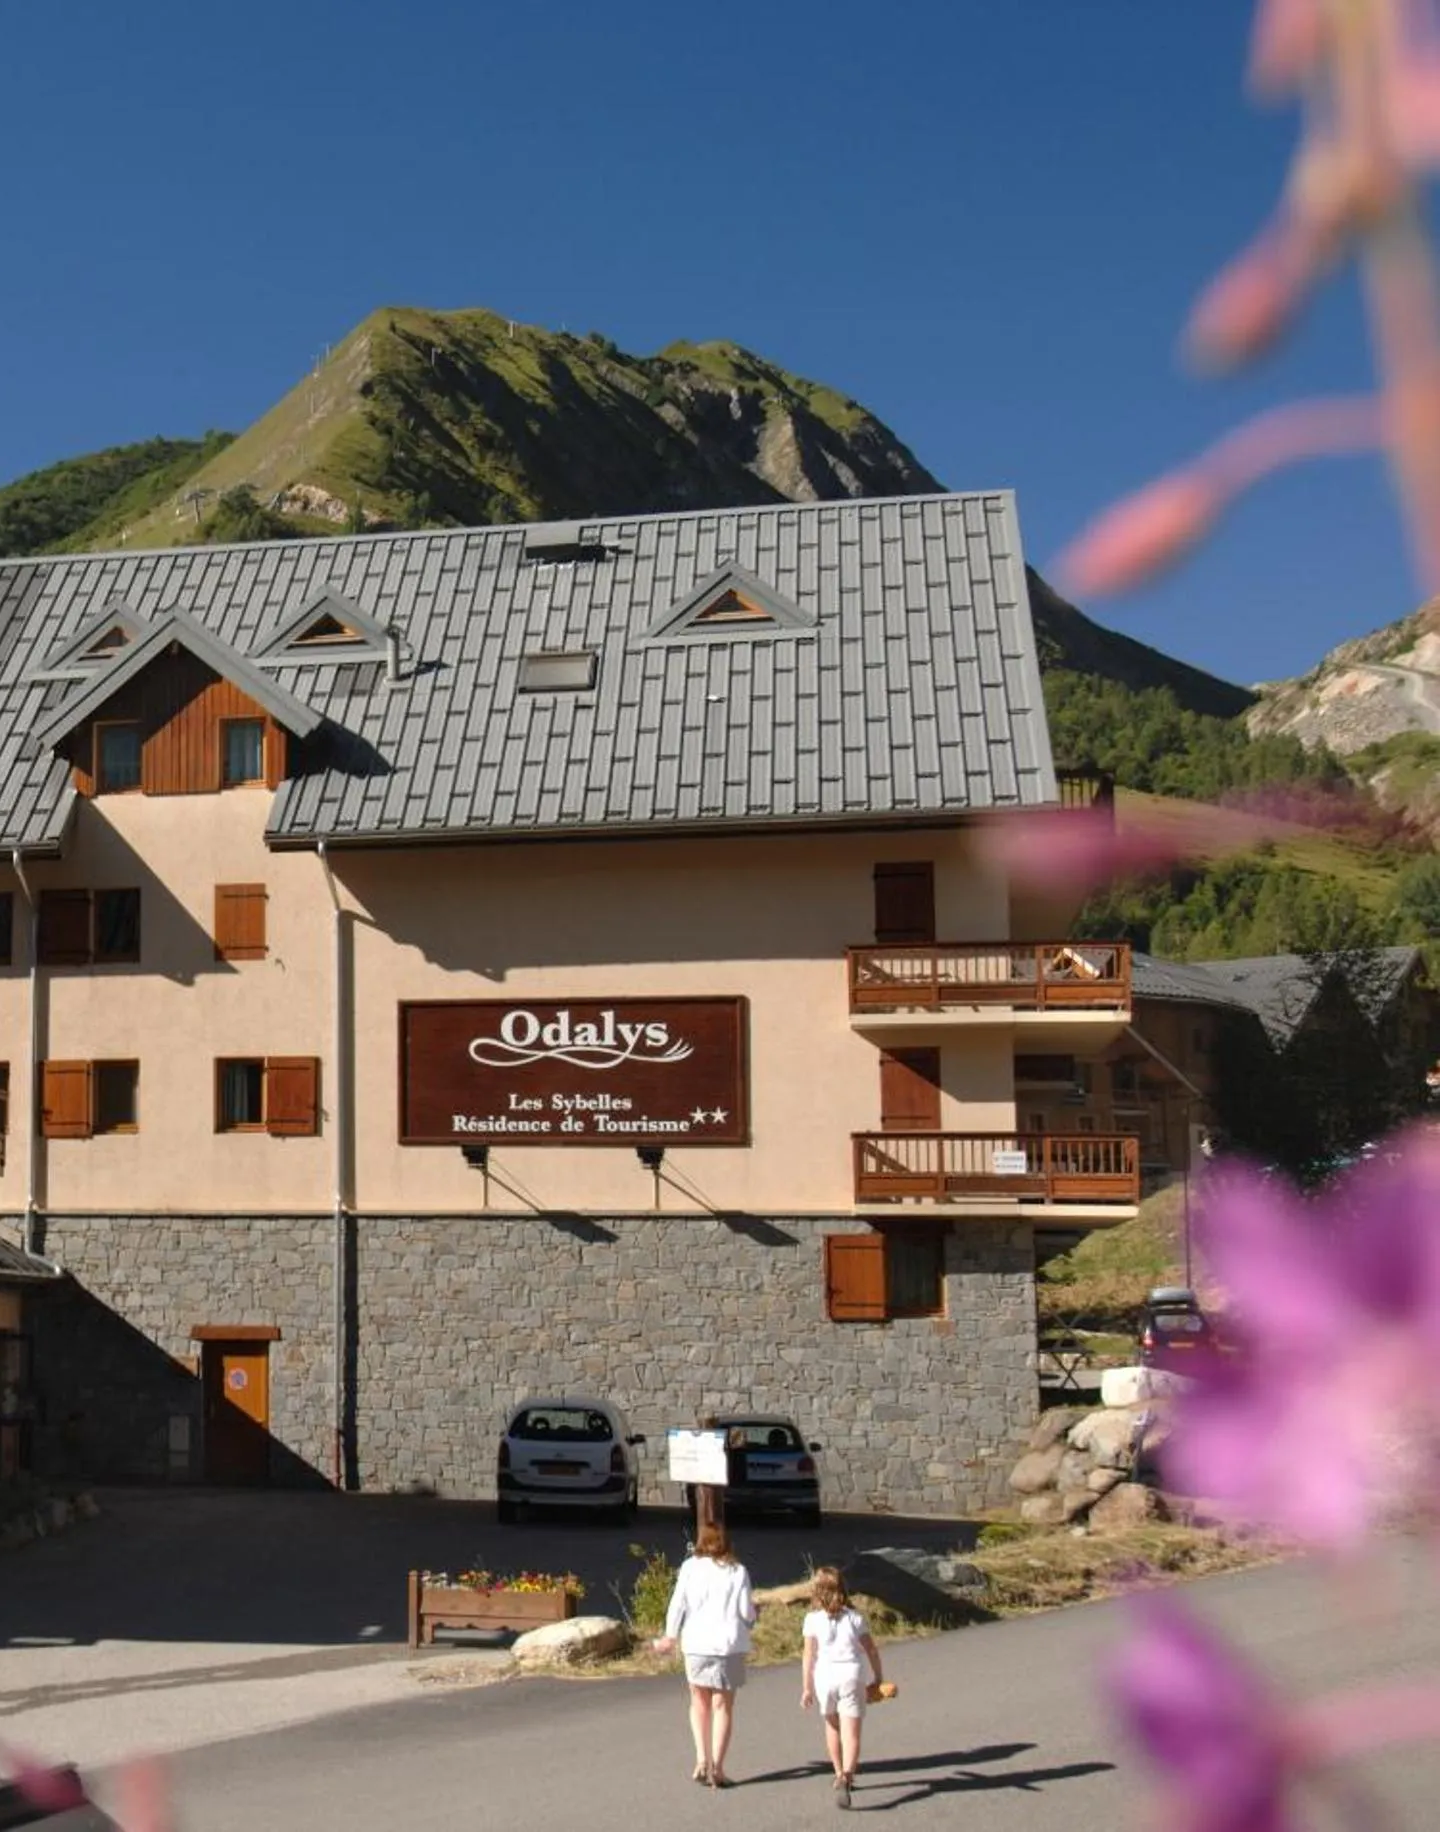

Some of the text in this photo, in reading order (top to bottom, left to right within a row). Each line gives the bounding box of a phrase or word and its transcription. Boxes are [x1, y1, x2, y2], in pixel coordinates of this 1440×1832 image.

[500, 1009, 669, 1058] Odalys
[509, 1093, 632, 1114] Les Sybelles
[452, 1113, 690, 1132] Résidence de Tourisme
